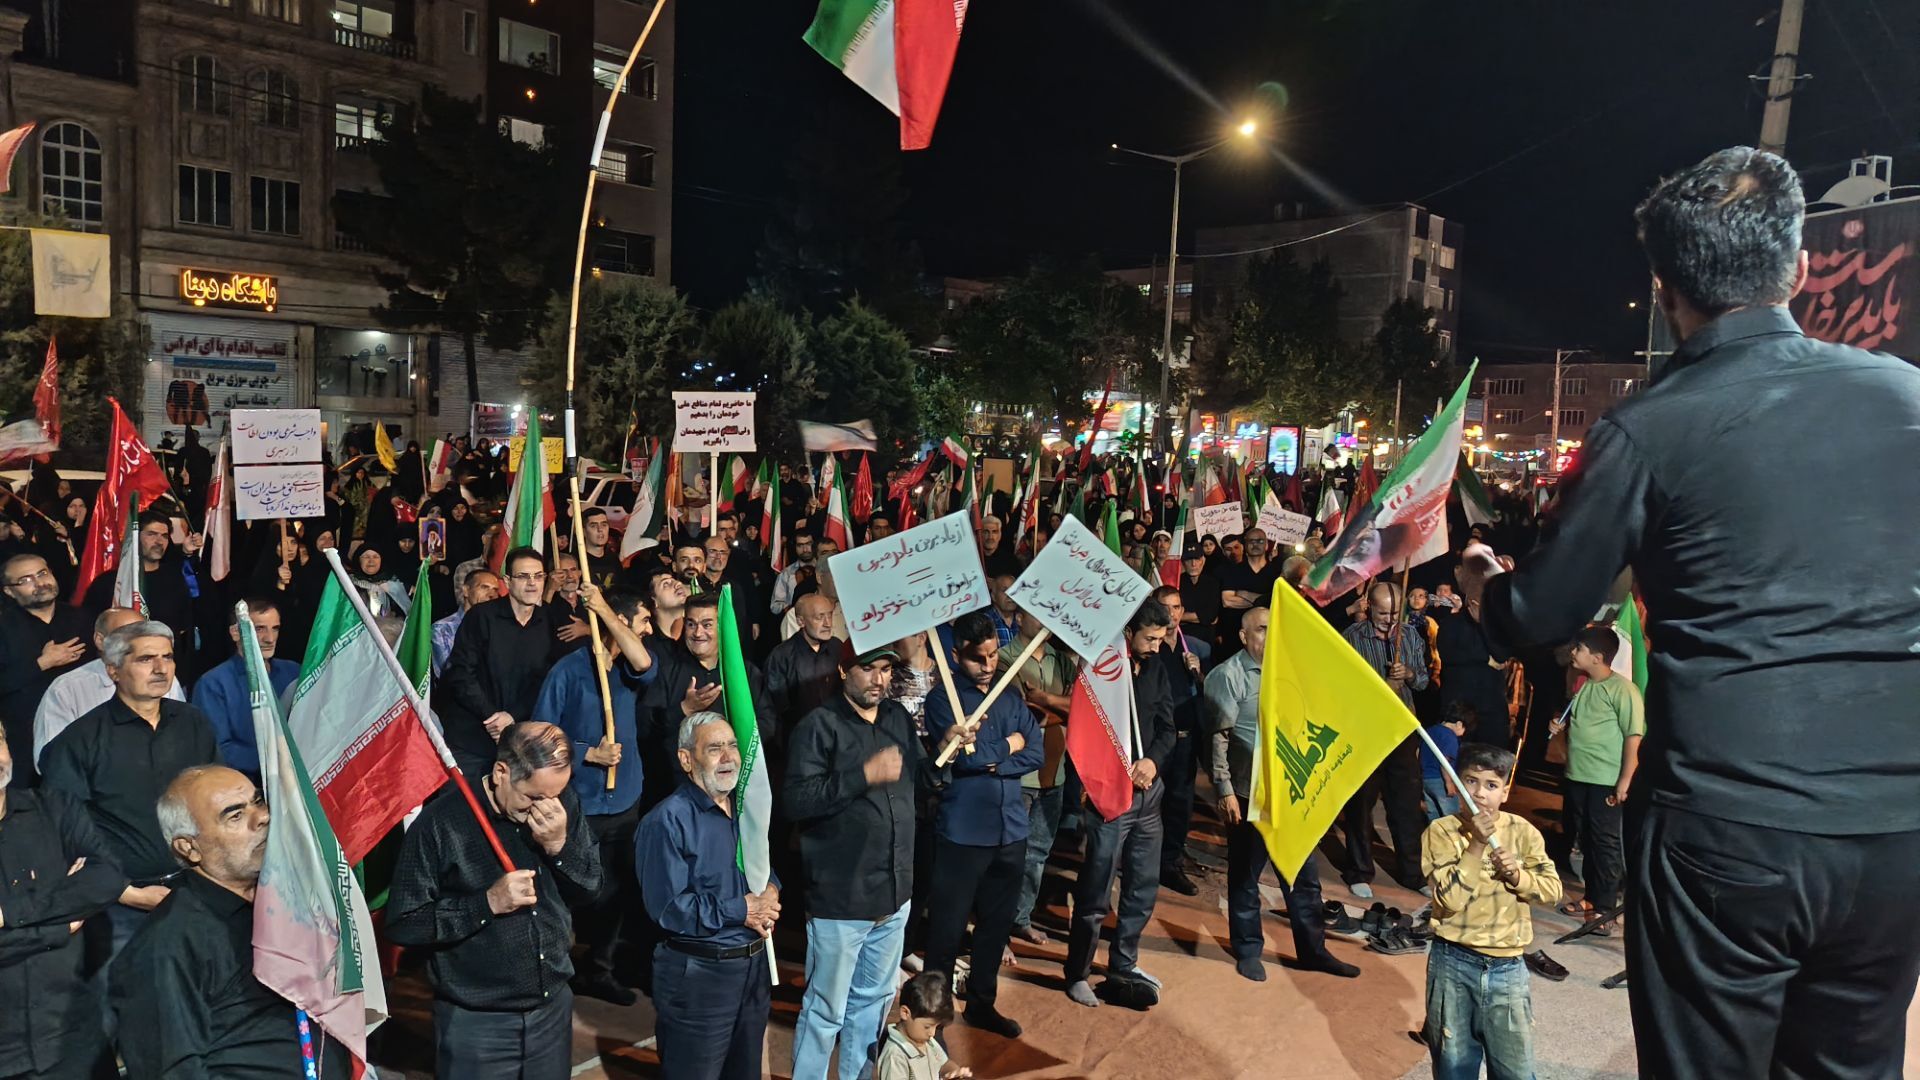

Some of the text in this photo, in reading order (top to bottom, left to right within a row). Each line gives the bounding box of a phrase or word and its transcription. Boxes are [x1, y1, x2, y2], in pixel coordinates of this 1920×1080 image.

[183, 269, 277, 312] باشگاه دینا
[164, 335, 184, 354] اس
[185, 336, 199, 354] ام
[199, 337, 215, 355] ای
[216, 337, 225, 356] با
[226, 340, 254, 357] اندام
[677, 401, 690, 409] ملی
[691, 400, 708, 409] منافع
[709, 400, 721, 408] تمام
[722, 400, 745, 409] حاضریم
[690, 411, 740, 419] خودمان را بدهیم
[258, 428, 280, 440] بودن
[294, 427, 317, 440] واجب
[680, 427, 706, 436] شهیدمان
[708, 427, 720, 436] امام
[738, 427, 751, 436] ولی
[703, 436, 729, 446] را بگیریم
[290, 445, 298, 456] از
[239, 481, 260, 495] است
[251, 481, 272, 497] ایران
[269, 484, 286, 495] ملت
[938, 570, 979, 599] فراموش
[908, 583, 937, 607] شدن
[931, 592, 979, 619] رهبری
